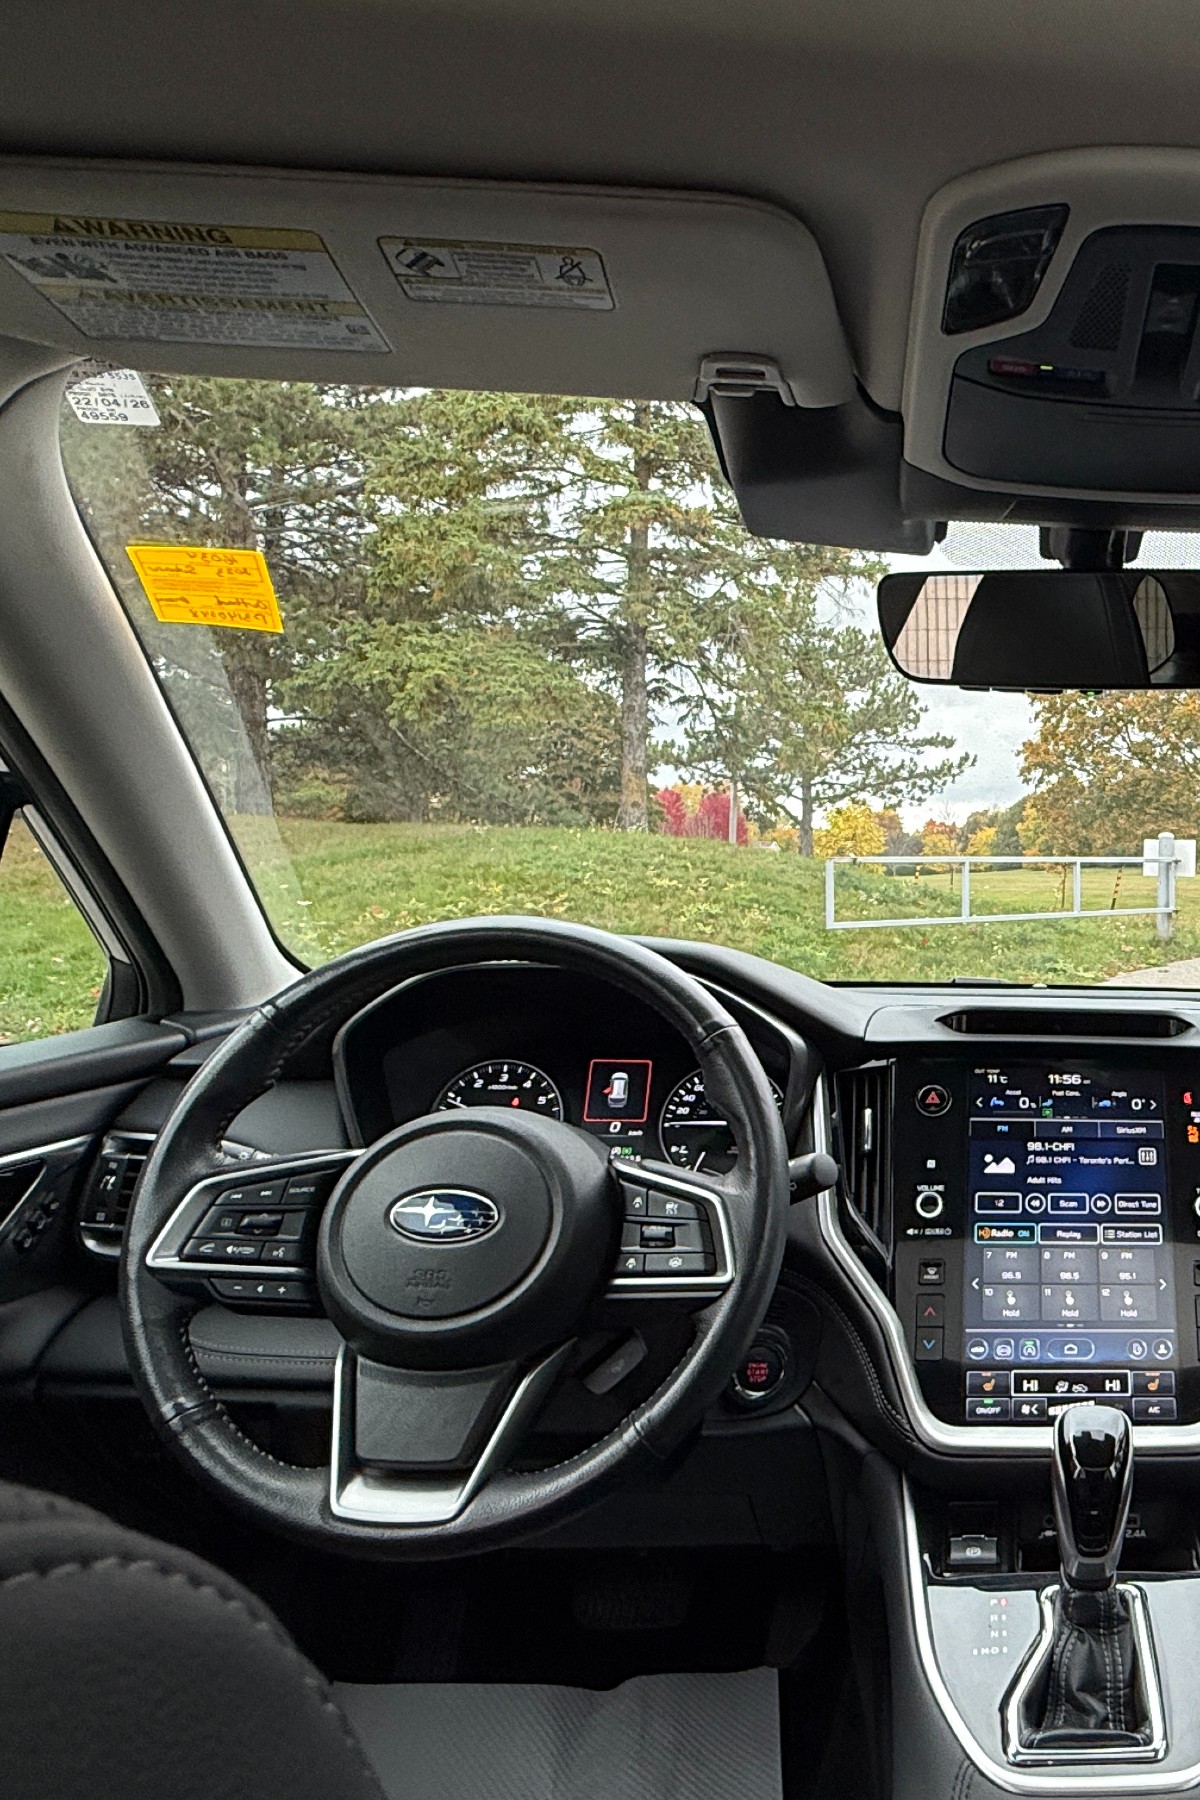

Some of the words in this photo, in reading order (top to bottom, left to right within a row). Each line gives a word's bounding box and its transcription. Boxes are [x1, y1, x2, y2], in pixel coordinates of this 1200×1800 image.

[73, 218, 233, 244] WARNING
[245, 251, 289, 260] BAGS
[499, 1073, 509, 1083] 3
[987, 1074, 998, 1084] 11
[1048, 1074, 1082, 1085] 11:56
[473, 1079, 484, 1088] 2
[522, 1080, 532, 1089] 4
[536, 1096, 547, 1105] 5
[682, 1094, 696, 1102] 40
[676, 1106, 690, 1115] 20
[609, 1121, 622, 1133] 0
[1116, 1126, 1147, 1134] SiriusXM
[1078, 1156, 1112, 1165] Toronto's
[1026, 1176, 1046, 1184] Adult
[1059, 1200, 1078, 1208] Scan
[1118, 1200, 1139, 1208] Direct
[1140, 1201, 1157, 1209] Tune
[991, 1229, 1015, 1238] Radio
[1017, 1229, 1030, 1237] ON
[1056, 1230, 1081, 1239] Replay
[1116, 1231, 1142, 1239] Station
[1143, 1231, 1158, 1239] List
[985, 1251, 993, 1259] 7
[1005, 1251, 1017, 1259] FM
[1121, 1252, 1133, 1260] FM
[984, 1288, 993, 1296] 10
[1044, 1288, 1051, 1296] 11
[1002, 1309, 1020, 1317] Hold
[1061, 1309, 1079, 1317] Hold
[1120, 1309, 1138, 1317] Hold
[747, 1368, 769, 1376] START
[748, 1375, 767, 1383] STOP
[1022, 1379, 1039, 1392] HI
[1104, 1379, 1121, 1392] HI
[990, 1614, 999, 1622] R
[990, 1630, 999, 1638] N
